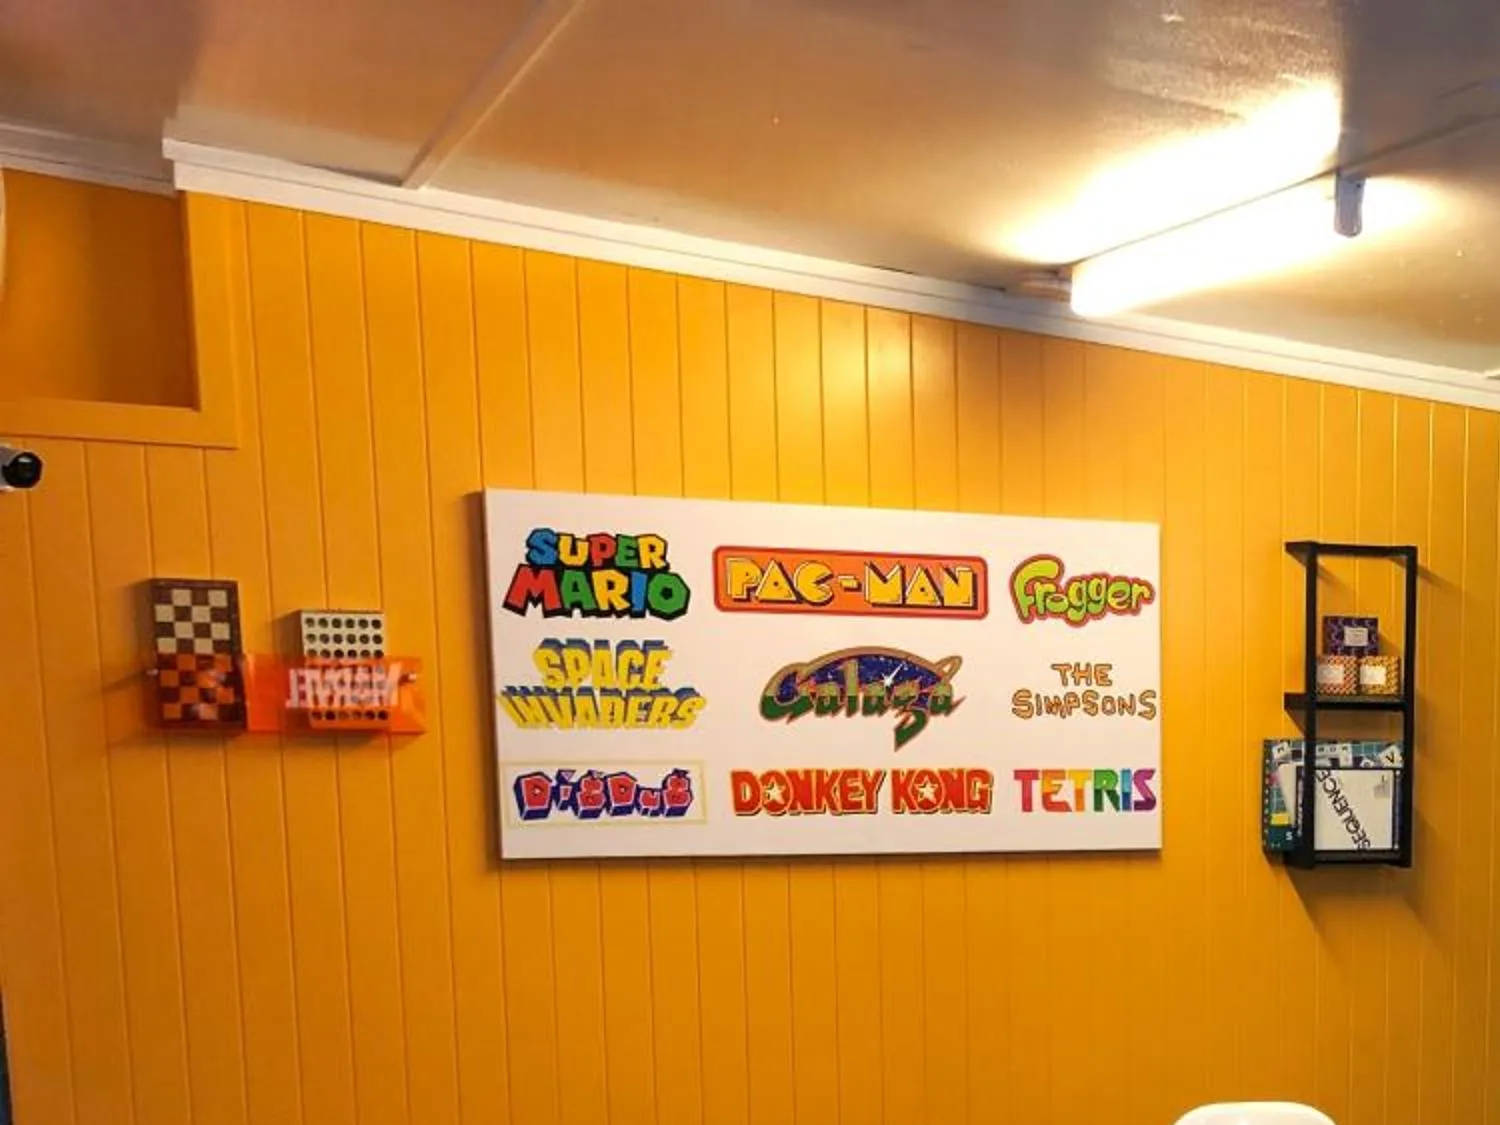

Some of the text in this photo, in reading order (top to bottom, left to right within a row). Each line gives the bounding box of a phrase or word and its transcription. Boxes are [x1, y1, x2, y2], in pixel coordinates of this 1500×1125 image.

[526, 527, 669, 571] SUPER
[501, 563, 692, 621] MARIO
[725, 555, 980, 609] PAC-MAN
[1010, 553, 1155, 627] Frogger
[533, 639, 675, 690] SPACE
[1051, 662, 1114, 688] THE
[499, 686, 708, 731] INVADERS
[760, 646, 966, 752] Galaga
[1011, 689, 1158, 720] SIMPSONS
[730, 768, 994, 815] DONKEY KONG
[1013, 767, 1158, 814] TETRIS
[1315, 769, 1372, 850] SEQUENCE
